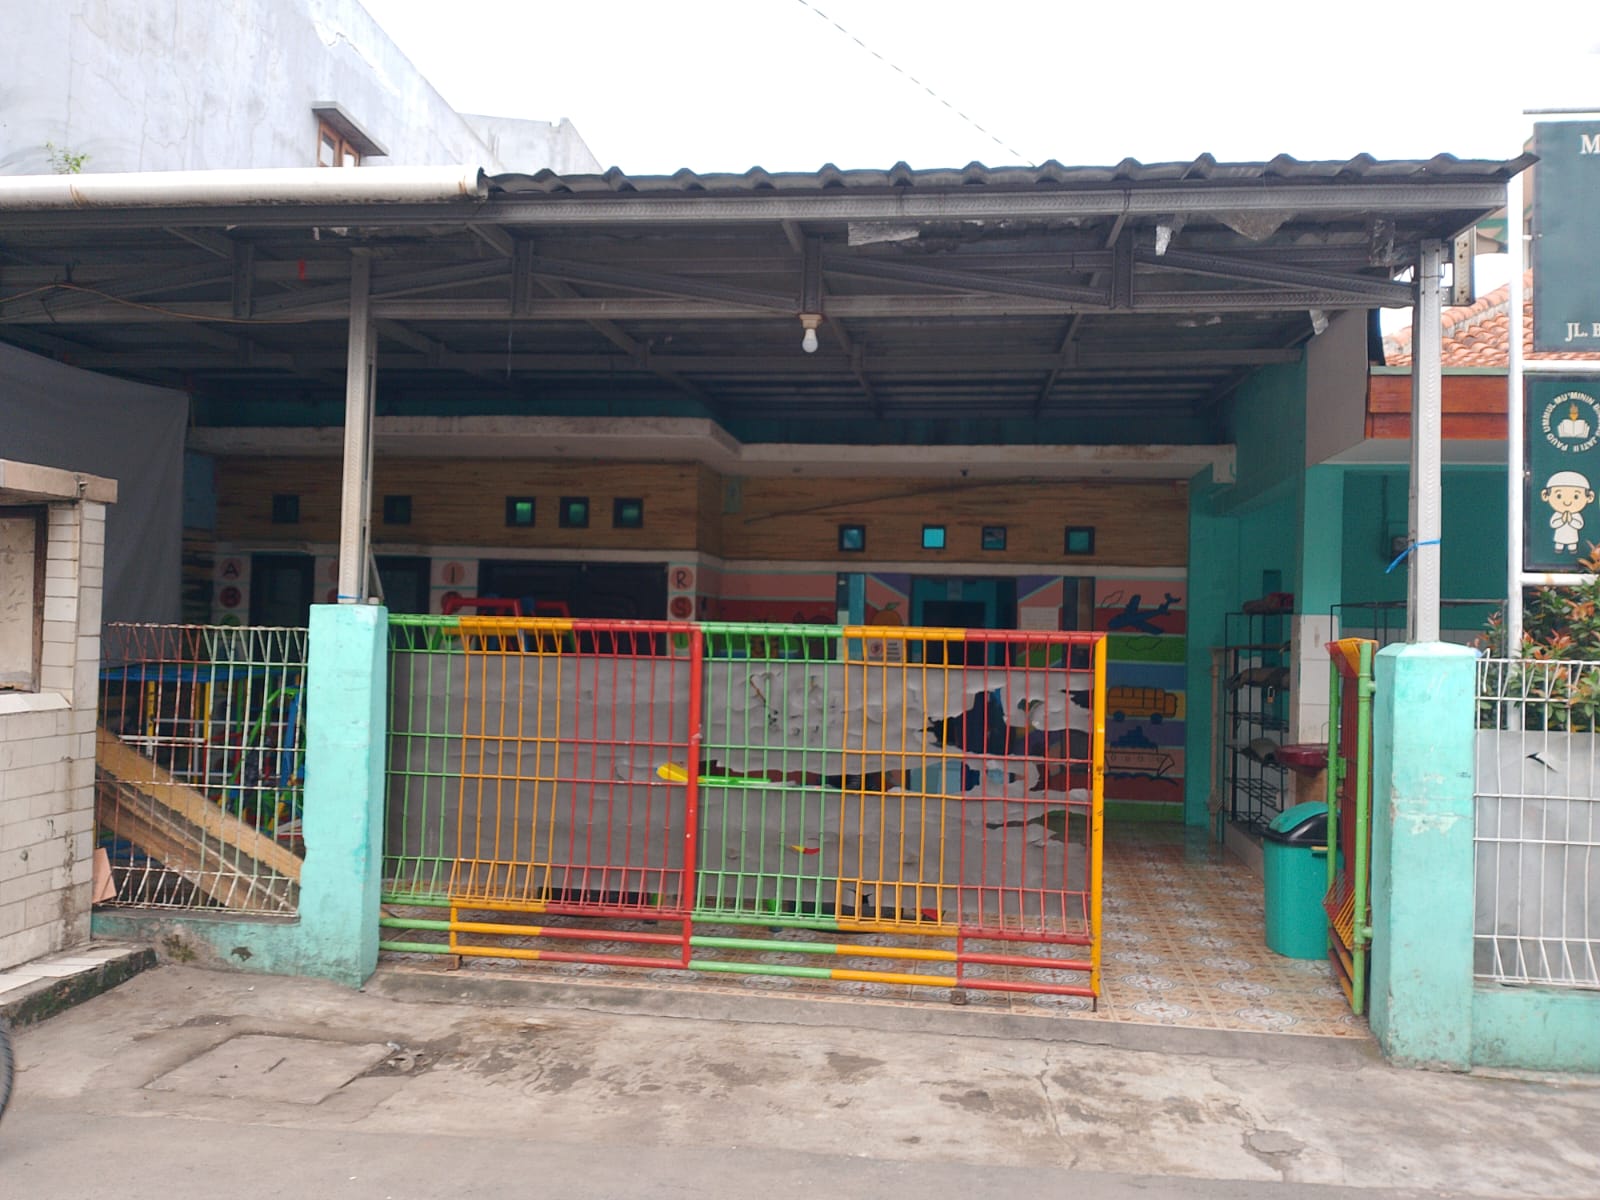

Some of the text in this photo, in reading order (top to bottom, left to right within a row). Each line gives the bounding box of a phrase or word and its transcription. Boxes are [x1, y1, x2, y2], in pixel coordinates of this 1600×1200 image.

[1564, 322, 1589, 343] JL.
[1546, 433, 1569, 452] PAUD
[675, 570, 688, 590] R
